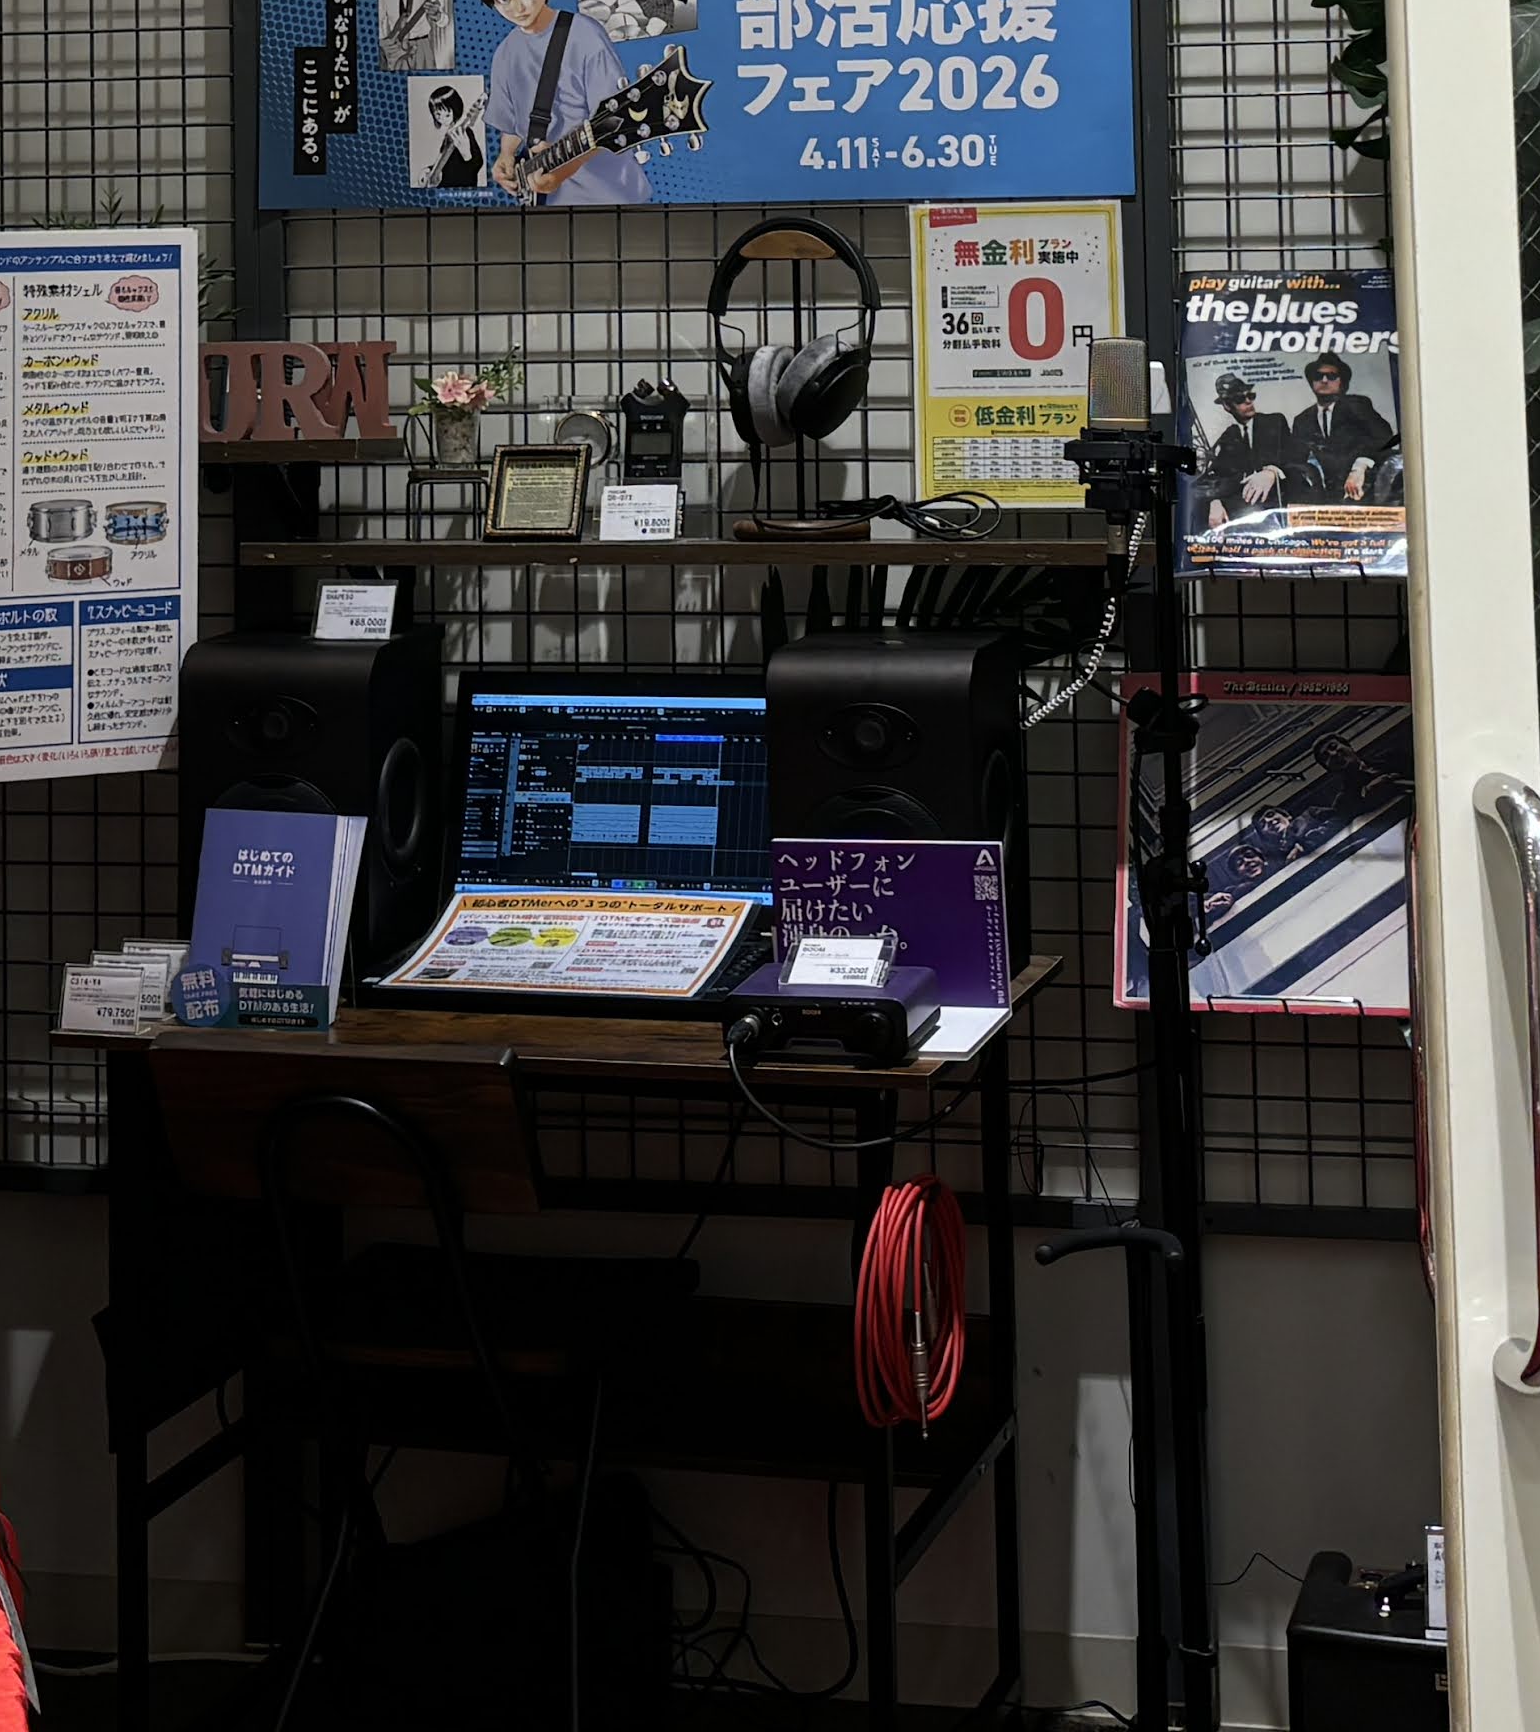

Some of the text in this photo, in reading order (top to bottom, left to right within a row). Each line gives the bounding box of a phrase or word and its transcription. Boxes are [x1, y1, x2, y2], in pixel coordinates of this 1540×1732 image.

[736, 54, 1059, 116] フェア2026
[302, 60, 319, 164] ここにある。
[953, 238, 1072, 267] 無金利 プラン
[1038, 250, 1079, 264] 実施中
[1189, 276, 1227, 292] play
[1228, 275, 1282, 290] guitar
[23, 307, 59, 321] アクリル
[1008, 277, 1065, 360] 0
[1072, 325, 1093, 347] 円
[1186, 294, 1359, 324] the blues
[942, 312, 969, 335] 36
[975, 404, 1035, 426] 低金利
[1039, 413, 1077, 425] プラン
[19, 547, 40, 557] メタル
[113, 577, 133, 587] ウッド
[237, 848, 294, 863] はじめての
[778, 850, 915, 872] ヘッドフォン
[232, 863, 295, 878] DTMガイド
[779, 875, 895, 898] ユーザーに
[781, 899, 873, 922] 届けたい
[181, 969, 215, 990] 無料
[239, 987, 304, 1000] 気軽にはじめる
[185, 999, 220, 1020] 配布
